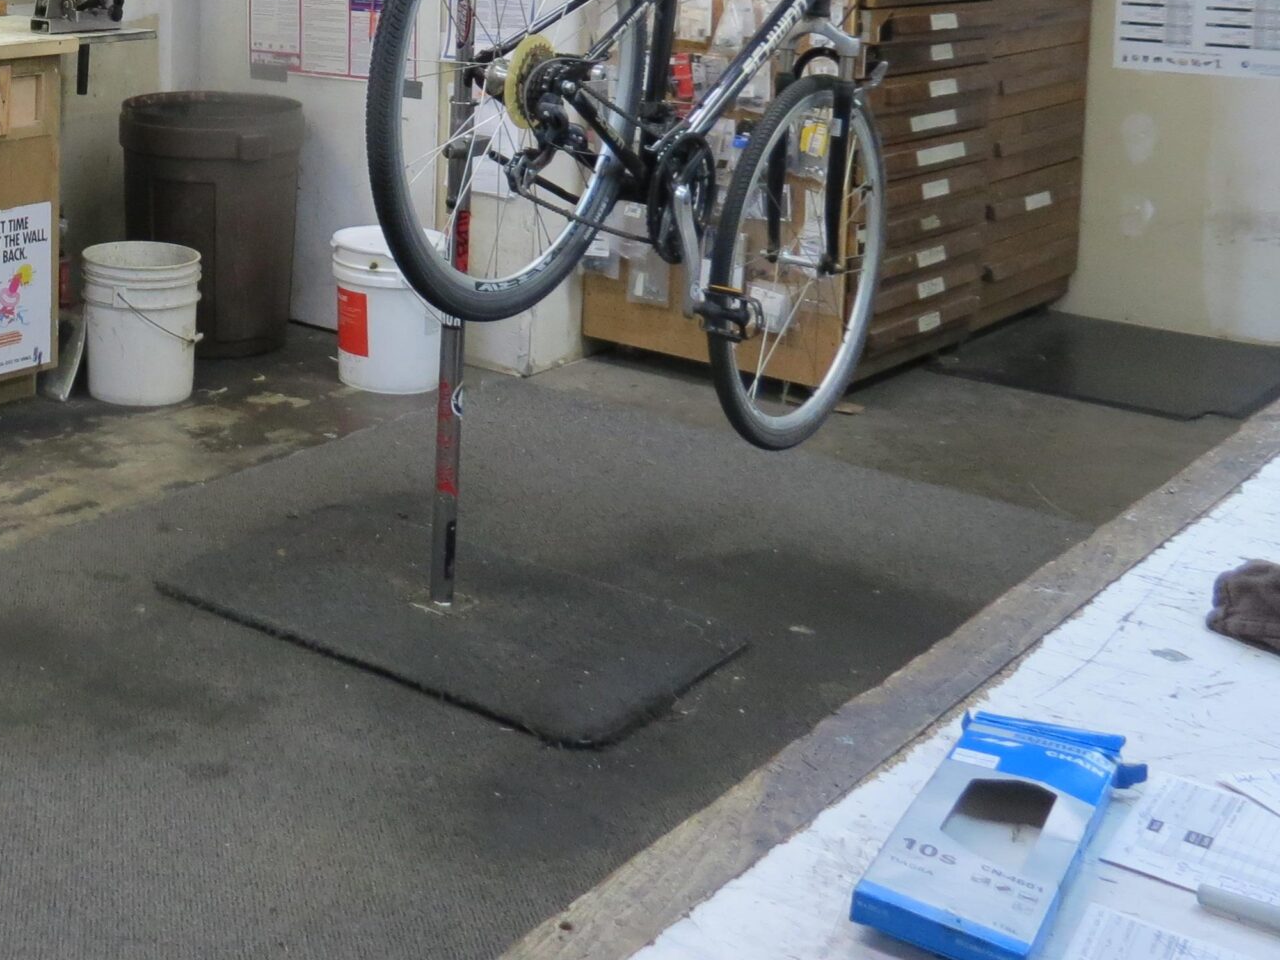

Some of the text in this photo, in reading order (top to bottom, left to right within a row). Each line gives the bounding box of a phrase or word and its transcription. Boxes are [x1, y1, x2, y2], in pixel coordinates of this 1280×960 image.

[8, 216, 29, 232] TIME
[4, 233, 20, 248] THE
[1045, 749, 1106, 778] CHAIN
[889, 855, 935, 877] TIAGRA
[980, 863, 1044, 894] CN-4601
